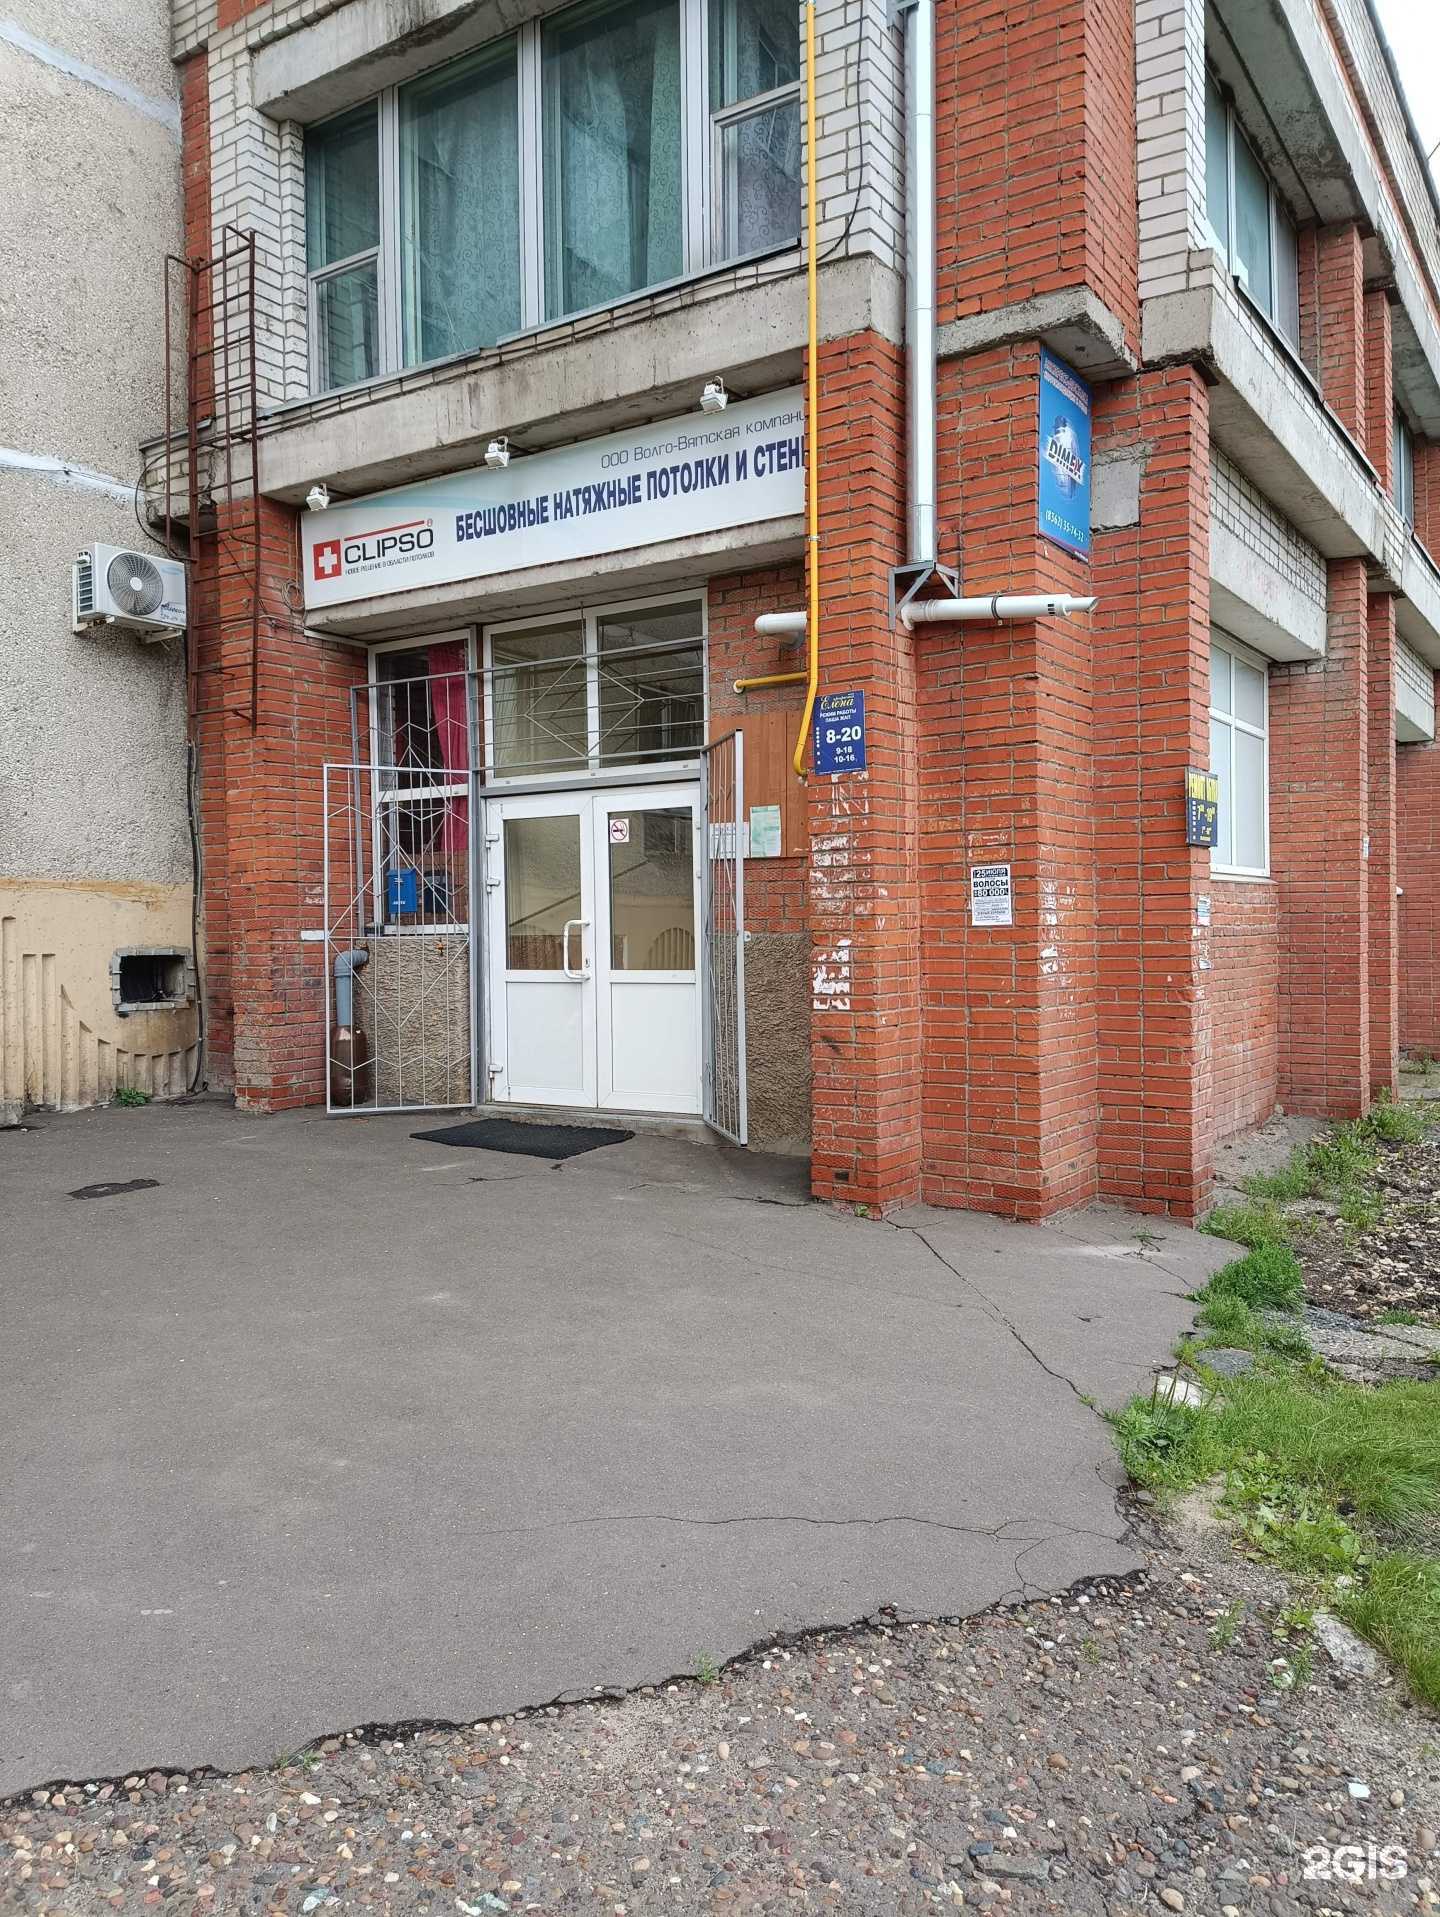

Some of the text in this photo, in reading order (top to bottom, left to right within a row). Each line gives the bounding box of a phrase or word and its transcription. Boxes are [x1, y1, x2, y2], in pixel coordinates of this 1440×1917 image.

[601, 450, 629, 469] ООО
[634, 426, 740, 461] Волго-Вятская
[456, 495, 549, 542] БЕСШОВНЫЕ
[553, 474, 642, 521] НАТЯЖНЫЕ
[647, 453, 730, 500] ПОТОЛКИ
[735, 449, 748, 482] И
[345, 528, 434, 564] CLIPSO
[836, 708, 857, 717] РАБОТЫ
[826, 725, 862, 744] 8-20
[834, 754, 855, 764] 10-16
[973, 879, 1009, 888] ВОЛОСЫ
